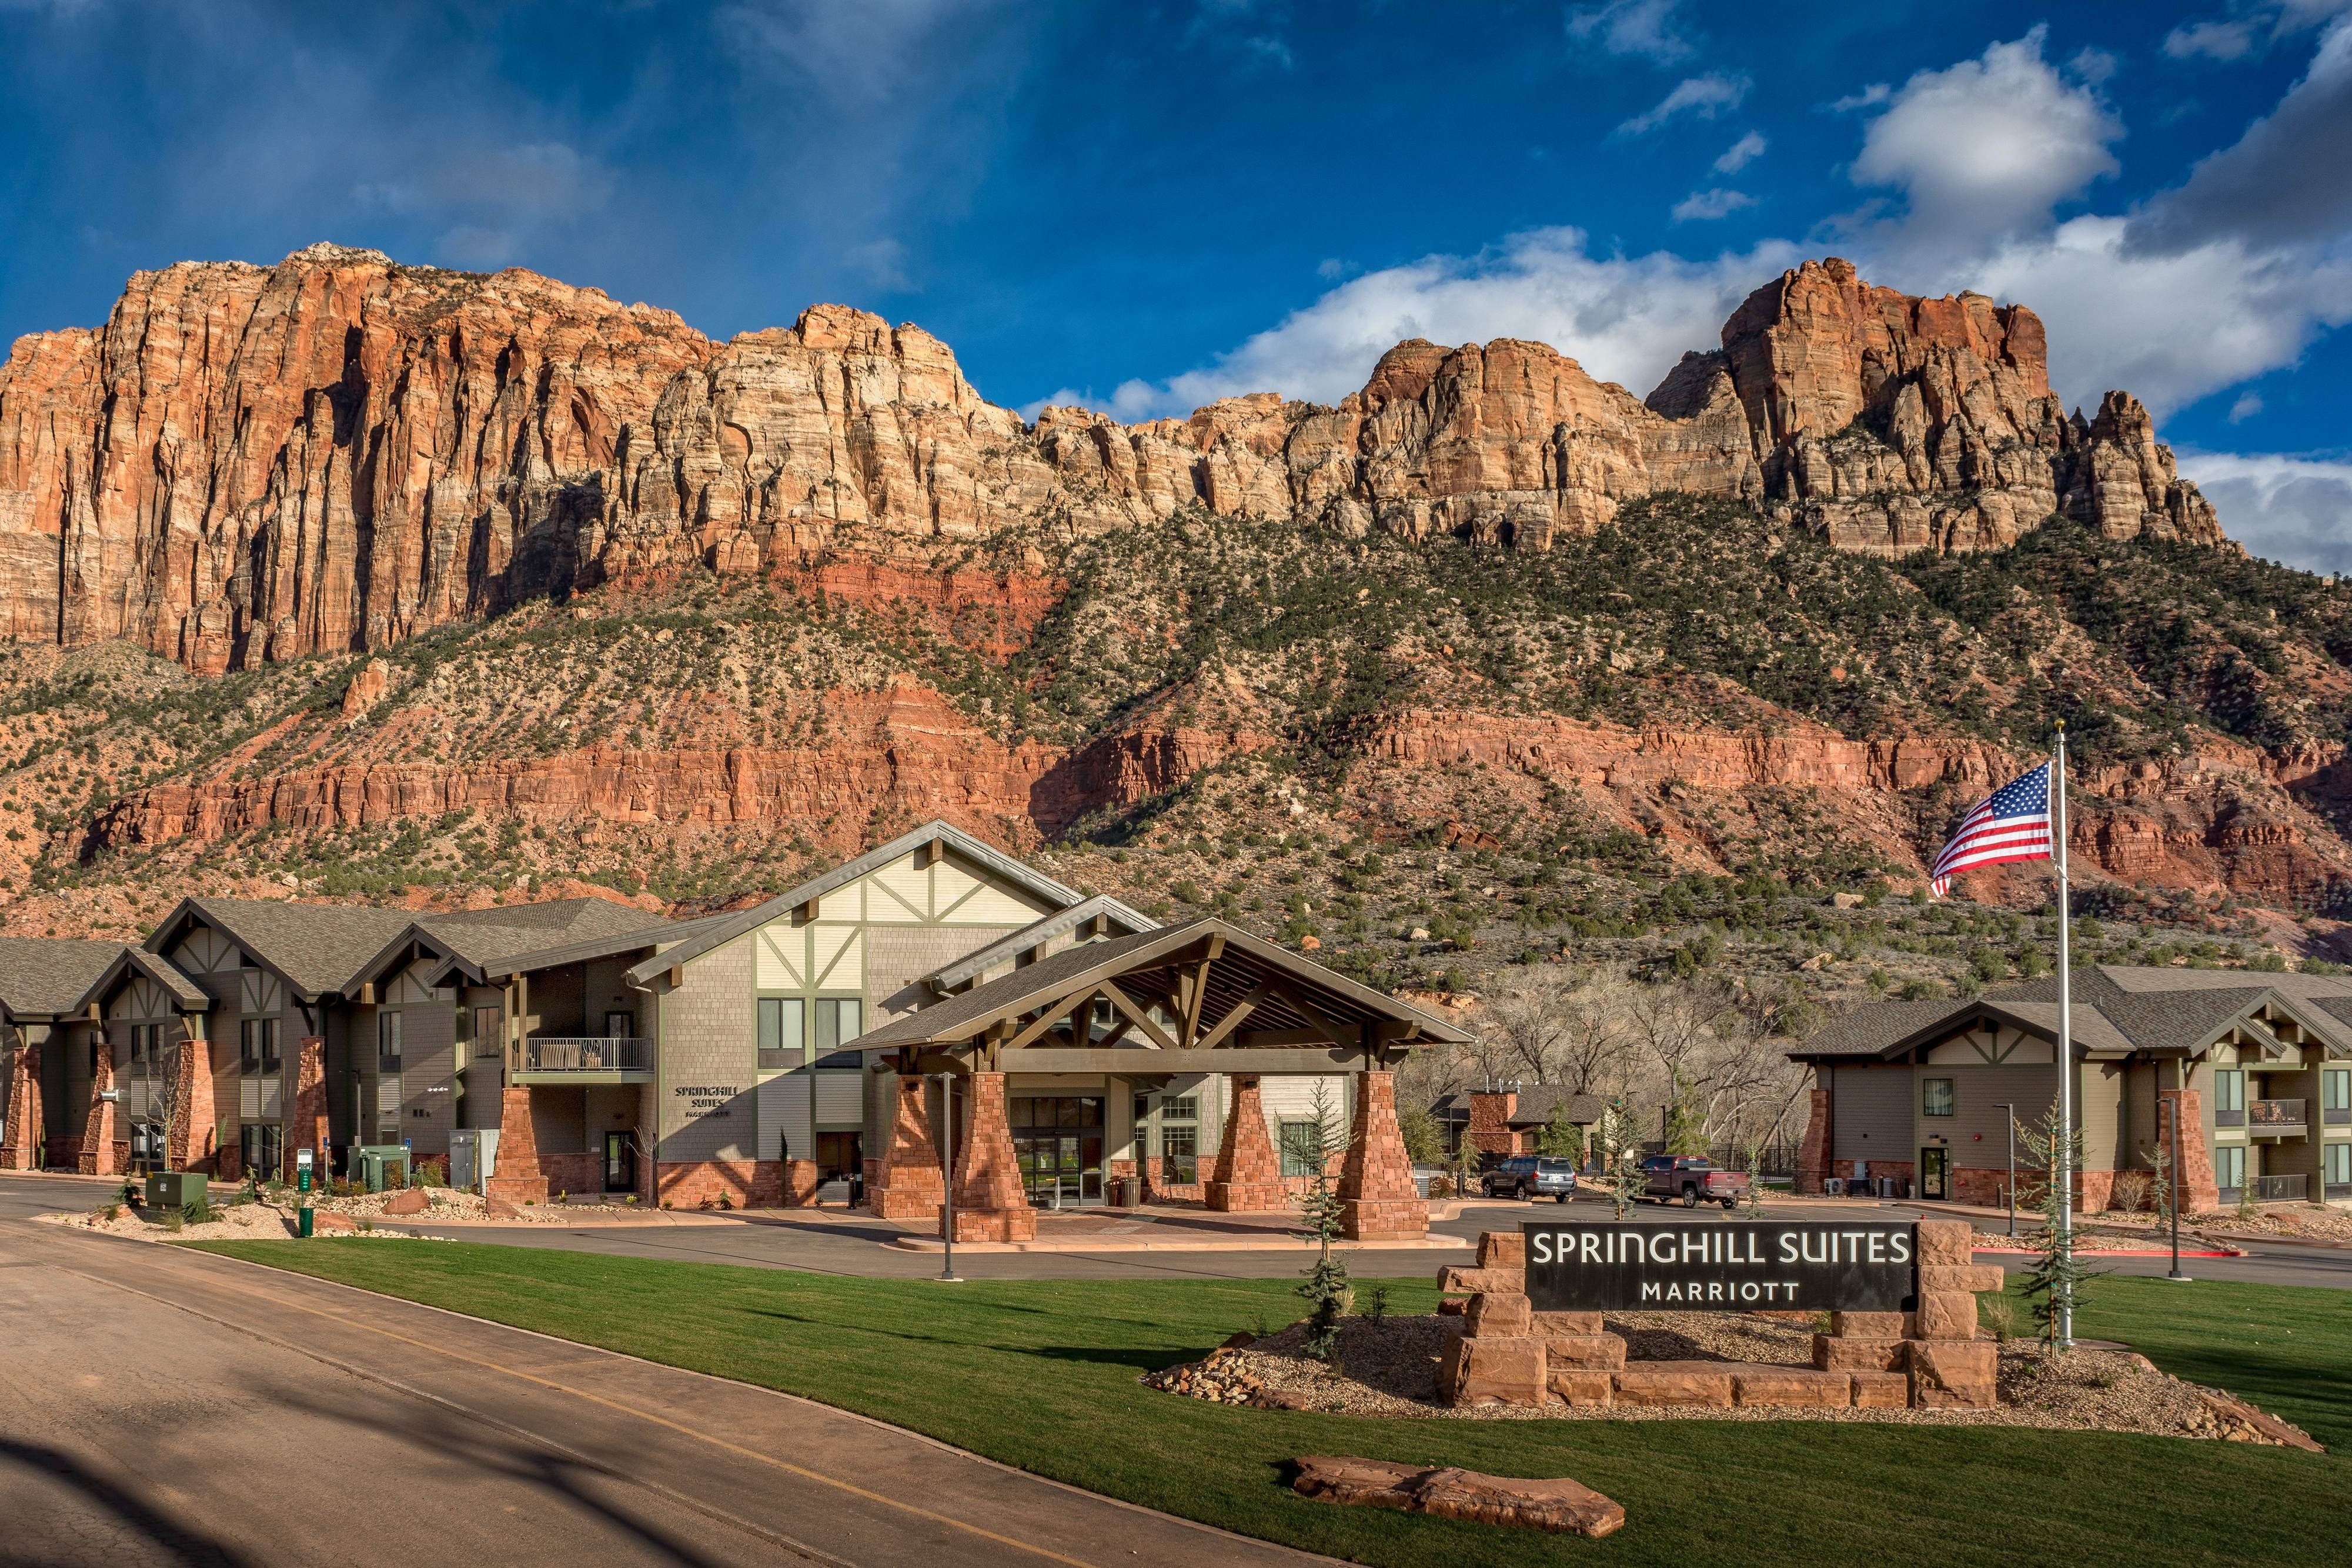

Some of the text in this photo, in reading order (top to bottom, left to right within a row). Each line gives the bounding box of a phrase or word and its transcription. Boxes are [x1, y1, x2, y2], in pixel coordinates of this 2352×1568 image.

[676, 1086, 738, 1096] SPRINGHILL
[691, 1098, 724, 1107] SUITES
[1532, 1232, 1765, 1263] SPRINGHILL
[1779, 1232, 1909, 1263] SUITES
[1642, 1282, 1799, 1301] MARRIOTT
